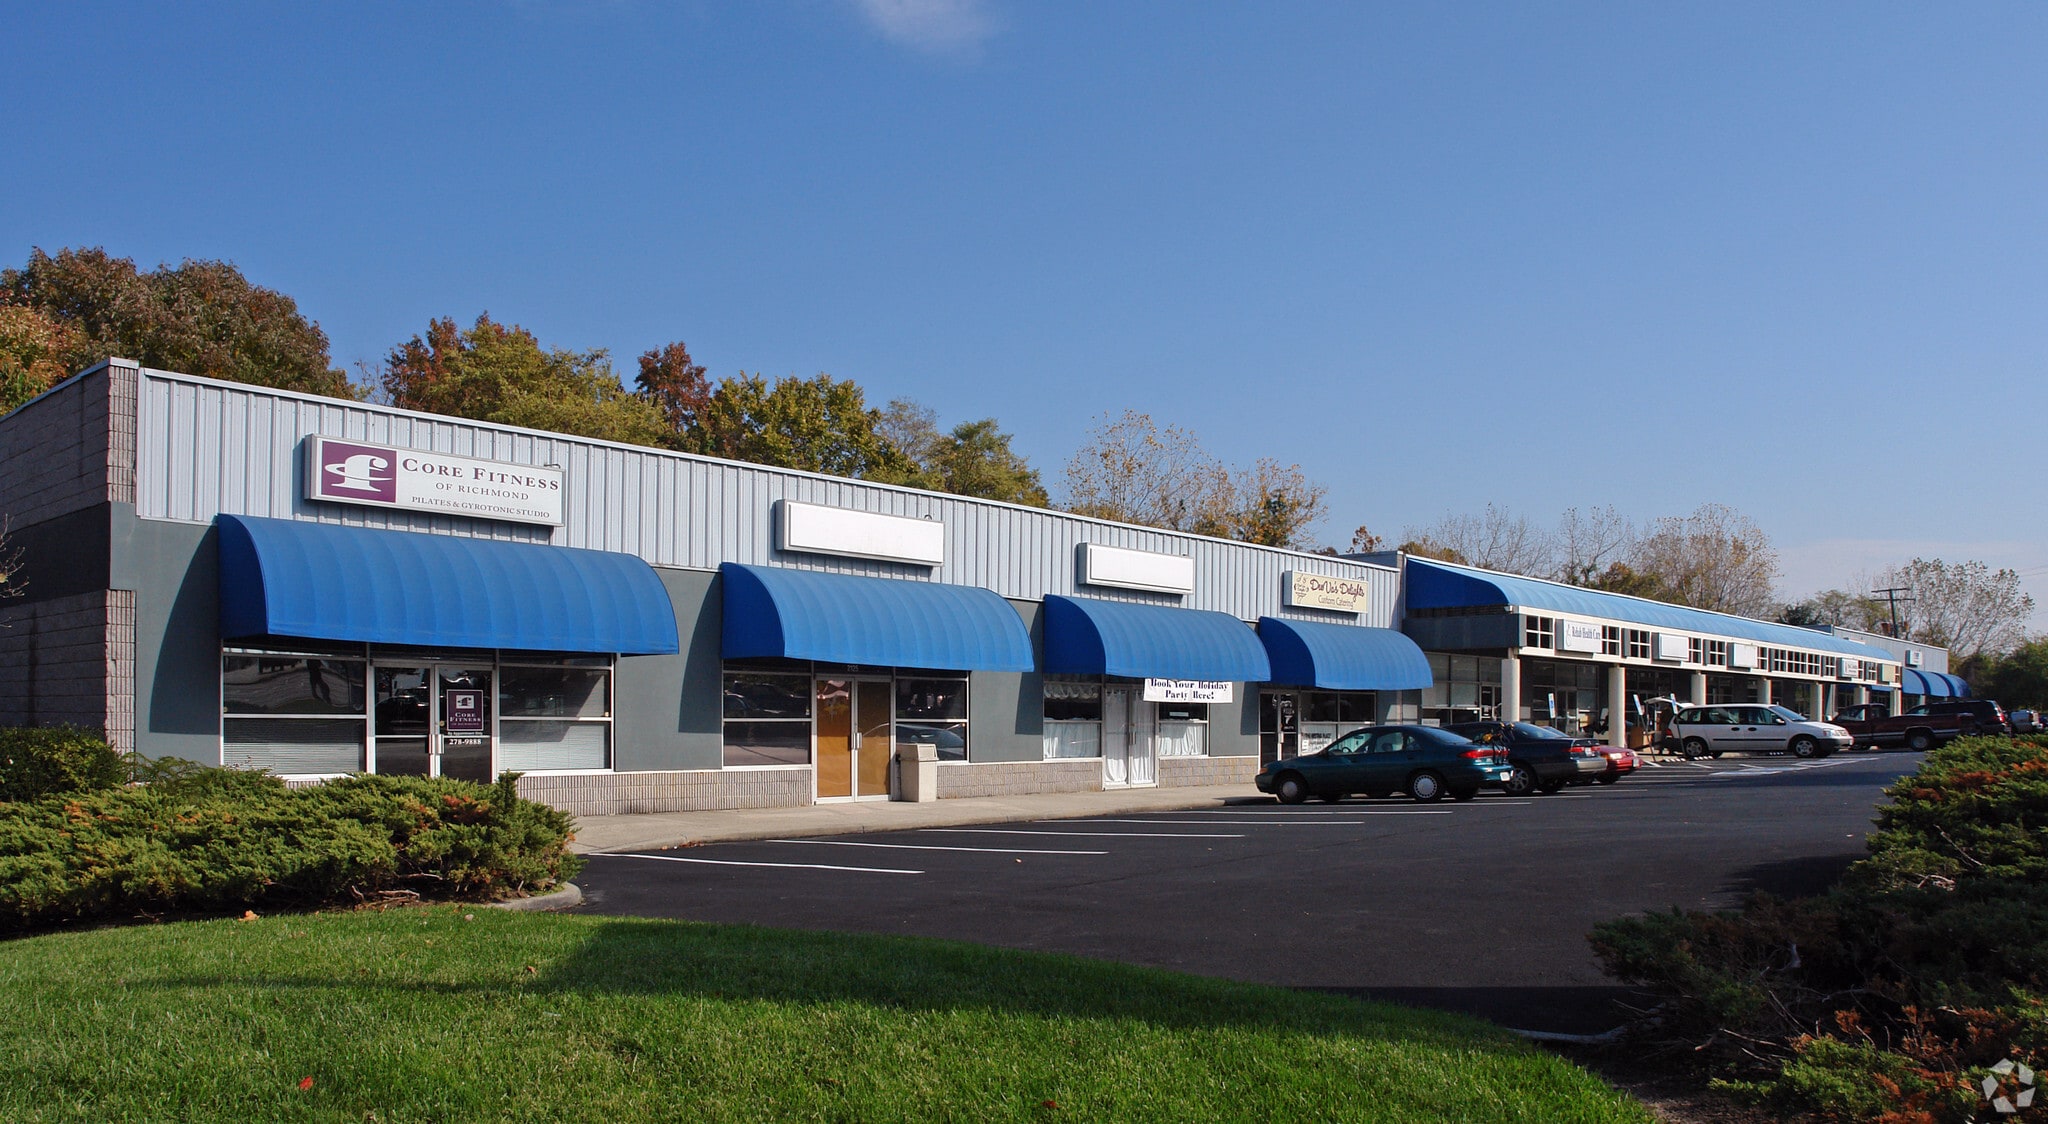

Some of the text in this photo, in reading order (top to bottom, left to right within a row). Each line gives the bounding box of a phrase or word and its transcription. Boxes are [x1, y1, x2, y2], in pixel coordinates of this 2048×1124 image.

[402, 458, 559, 490] CORE FITNESS
[435, 482, 529, 500] OF RICHMOND
[411, 496, 451, 507] PILATES
[461, 502, 515, 514] GYROTONIC
[516, 509, 550, 518] STUDIO
[1151, 678, 1229, 691] Book Your Holiday
[1165, 690, 1214, 701] Party Here!
